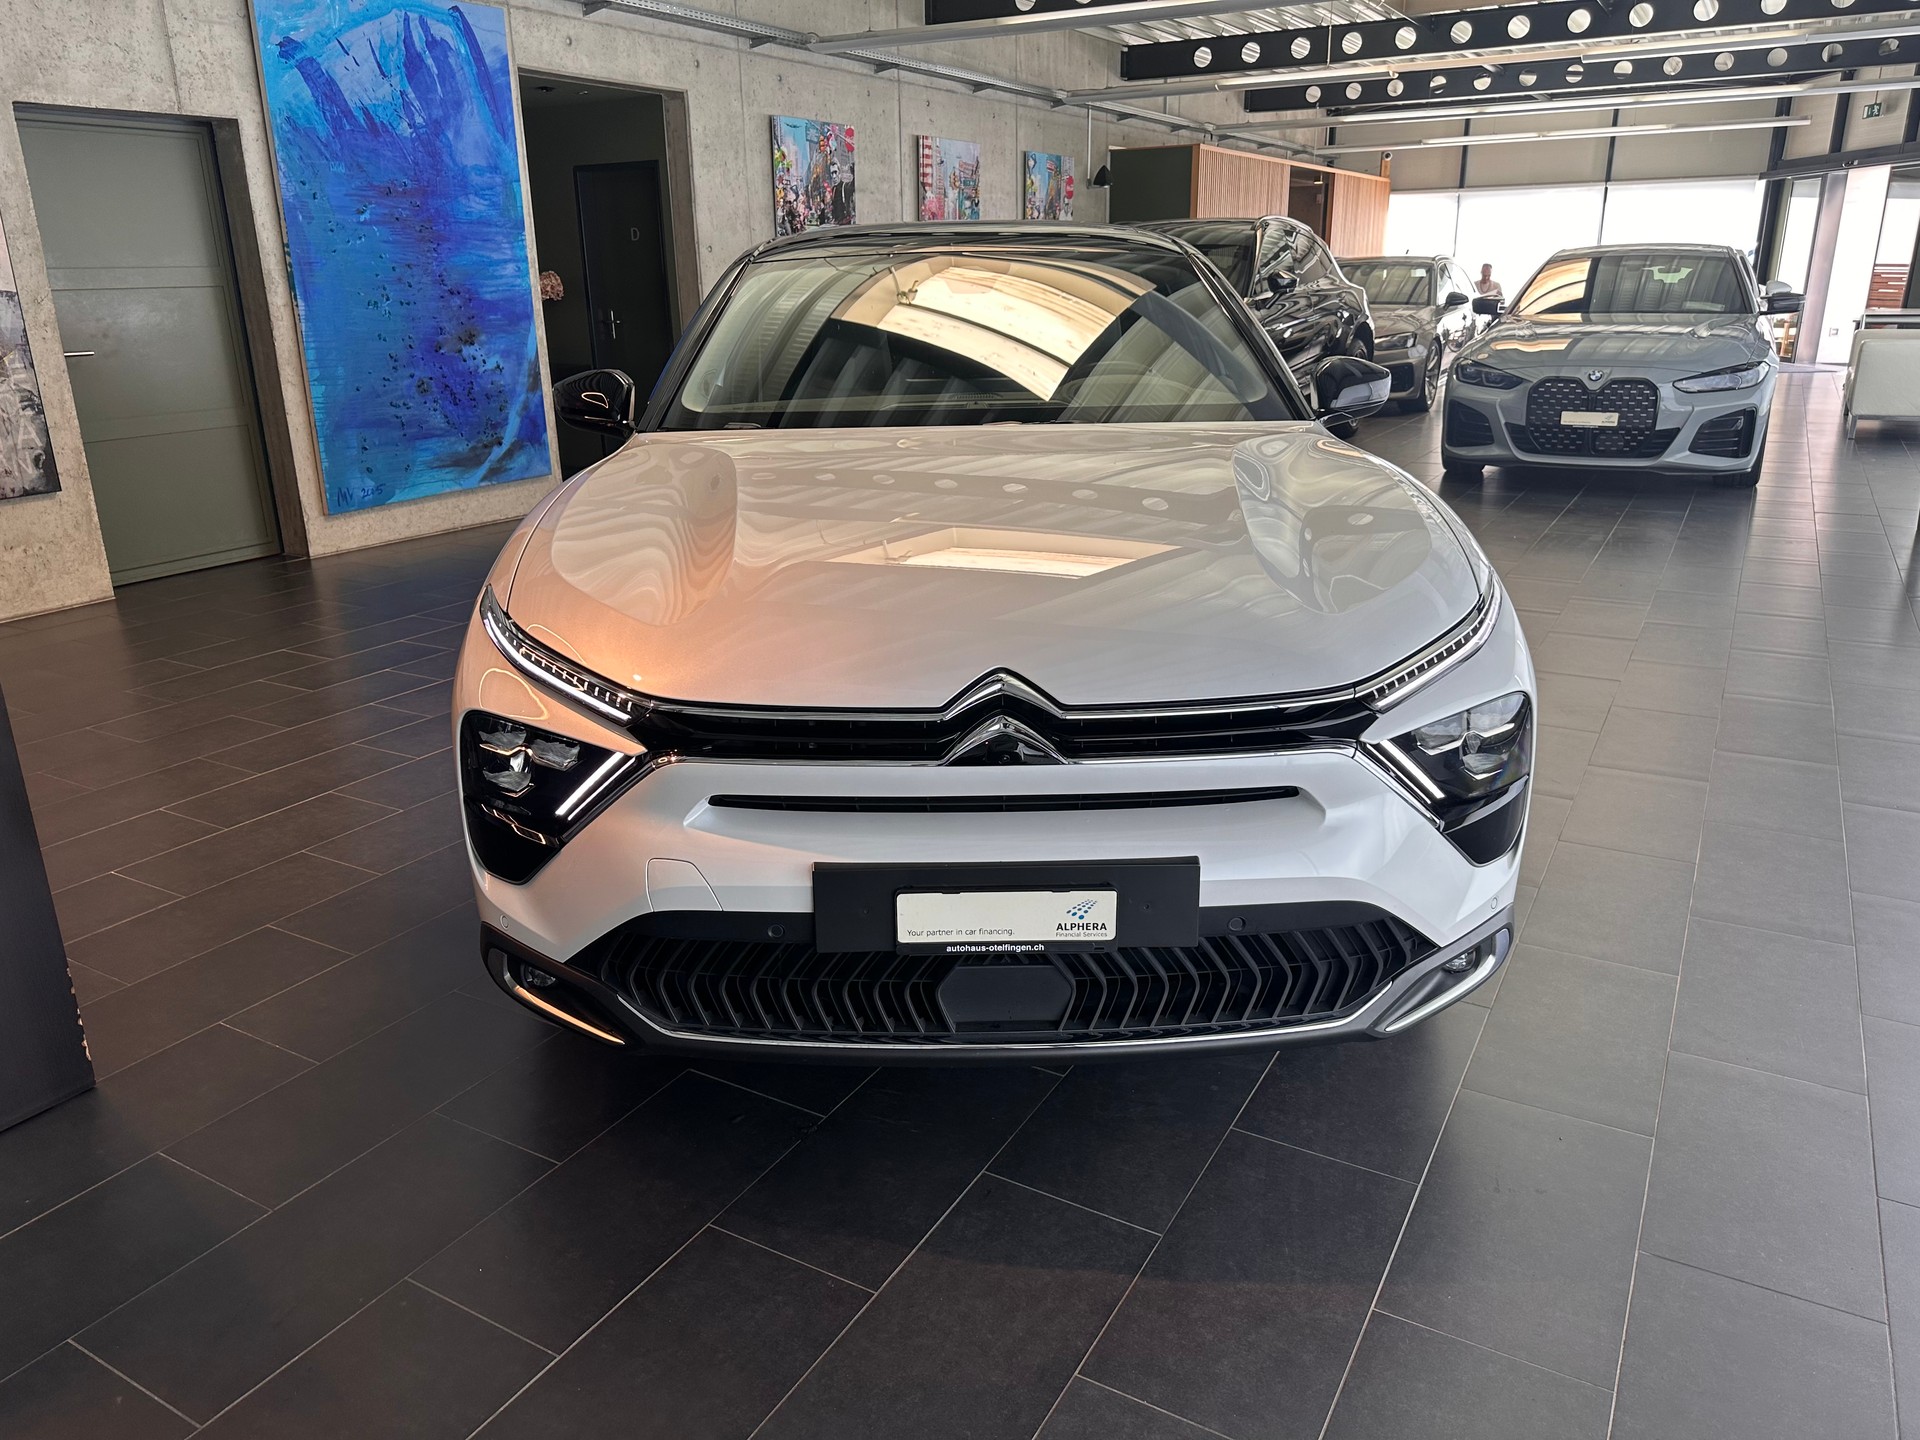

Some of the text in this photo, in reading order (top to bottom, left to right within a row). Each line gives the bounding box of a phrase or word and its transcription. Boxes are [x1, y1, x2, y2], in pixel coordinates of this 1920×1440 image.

[630, 228, 639, 240] D
[1056, 922, 1107, 931] ALPHERA
[907, 929, 923, 937] Your
[926, 929, 953, 937] partner
[978, 928, 1015, 937] financing.
[946, 943, 1045, 953] autohaus-otelfingen.ch
